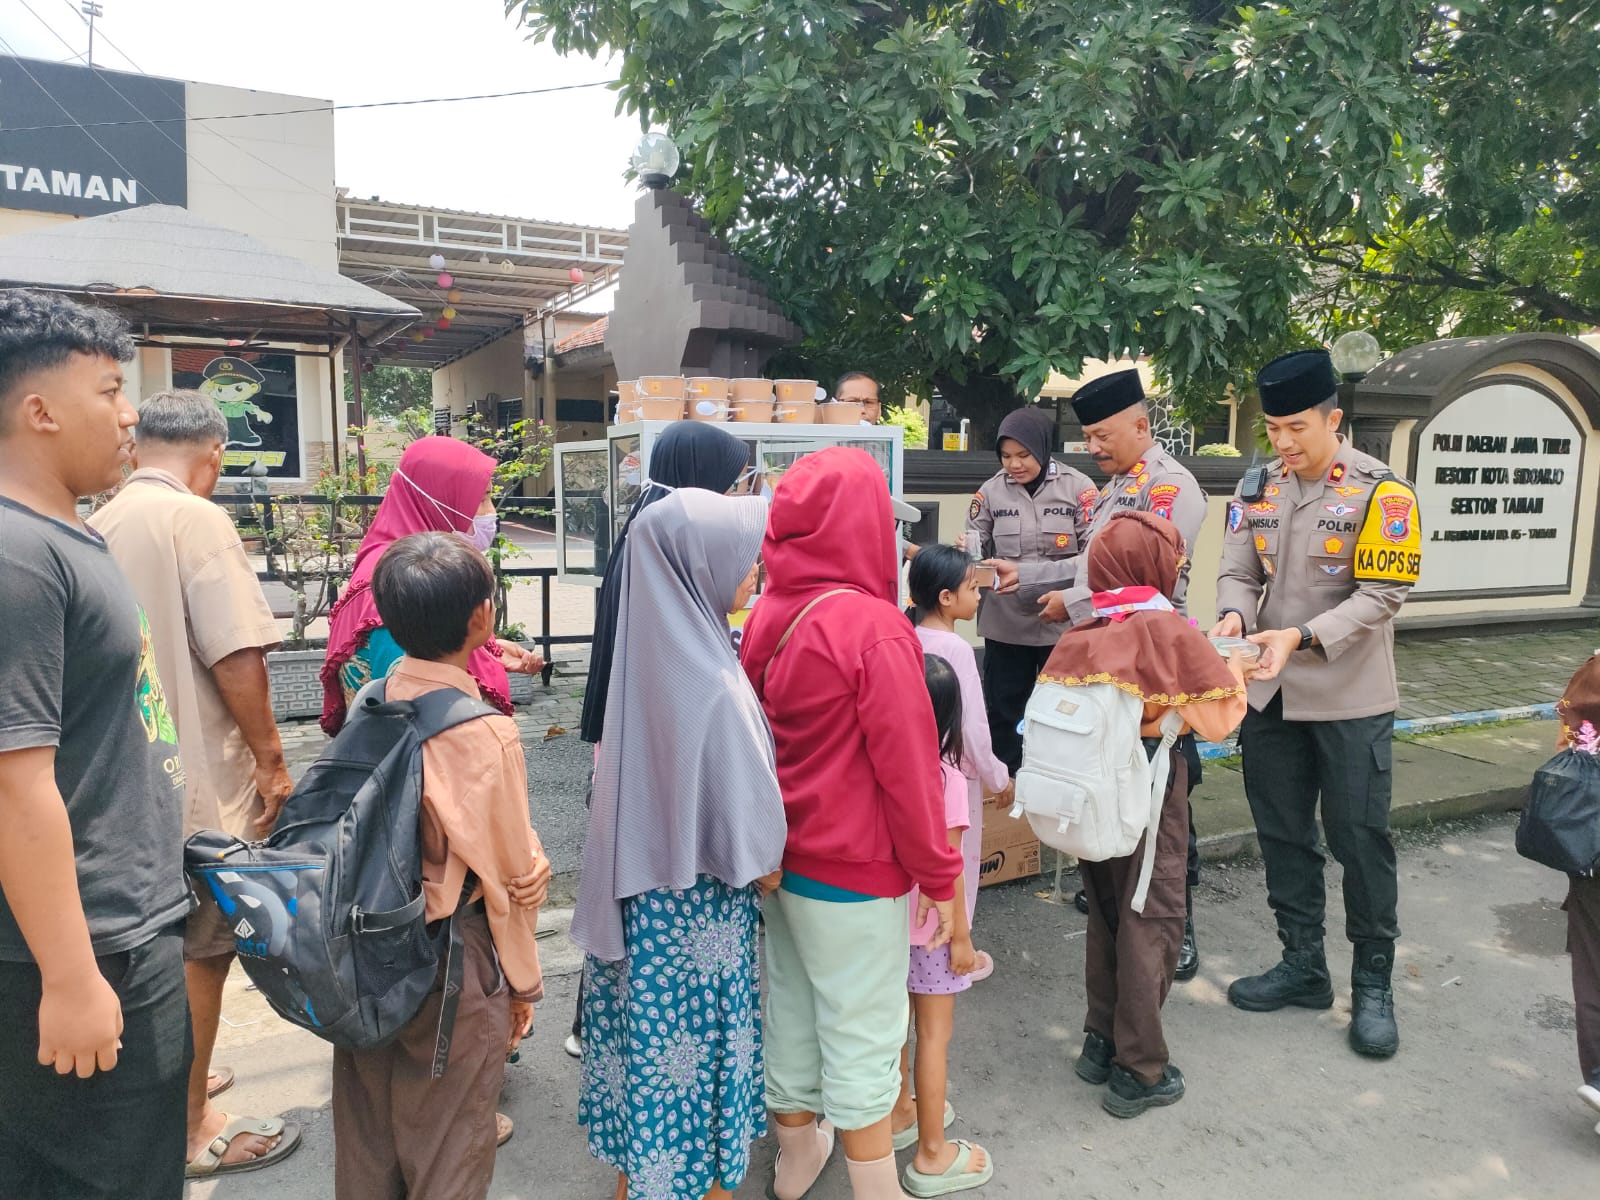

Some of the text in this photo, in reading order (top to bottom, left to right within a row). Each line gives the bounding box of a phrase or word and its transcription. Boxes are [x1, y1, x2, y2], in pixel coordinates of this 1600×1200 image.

[0, 164, 137, 204] TAMAN
[1466, 435, 1507, 453] DAERAH
[1481, 467, 1509, 484] KOTA
[1513, 468, 1564, 485] SIDOARJO
[1043, 507, 1075, 517] POLRI
[1450, 497, 1544, 515] SEKTOR TAMAN
[1317, 519, 1357, 533] POLRI
[1357, 548, 1374, 571] KA
[1376, 549, 1405, 574] OPS
